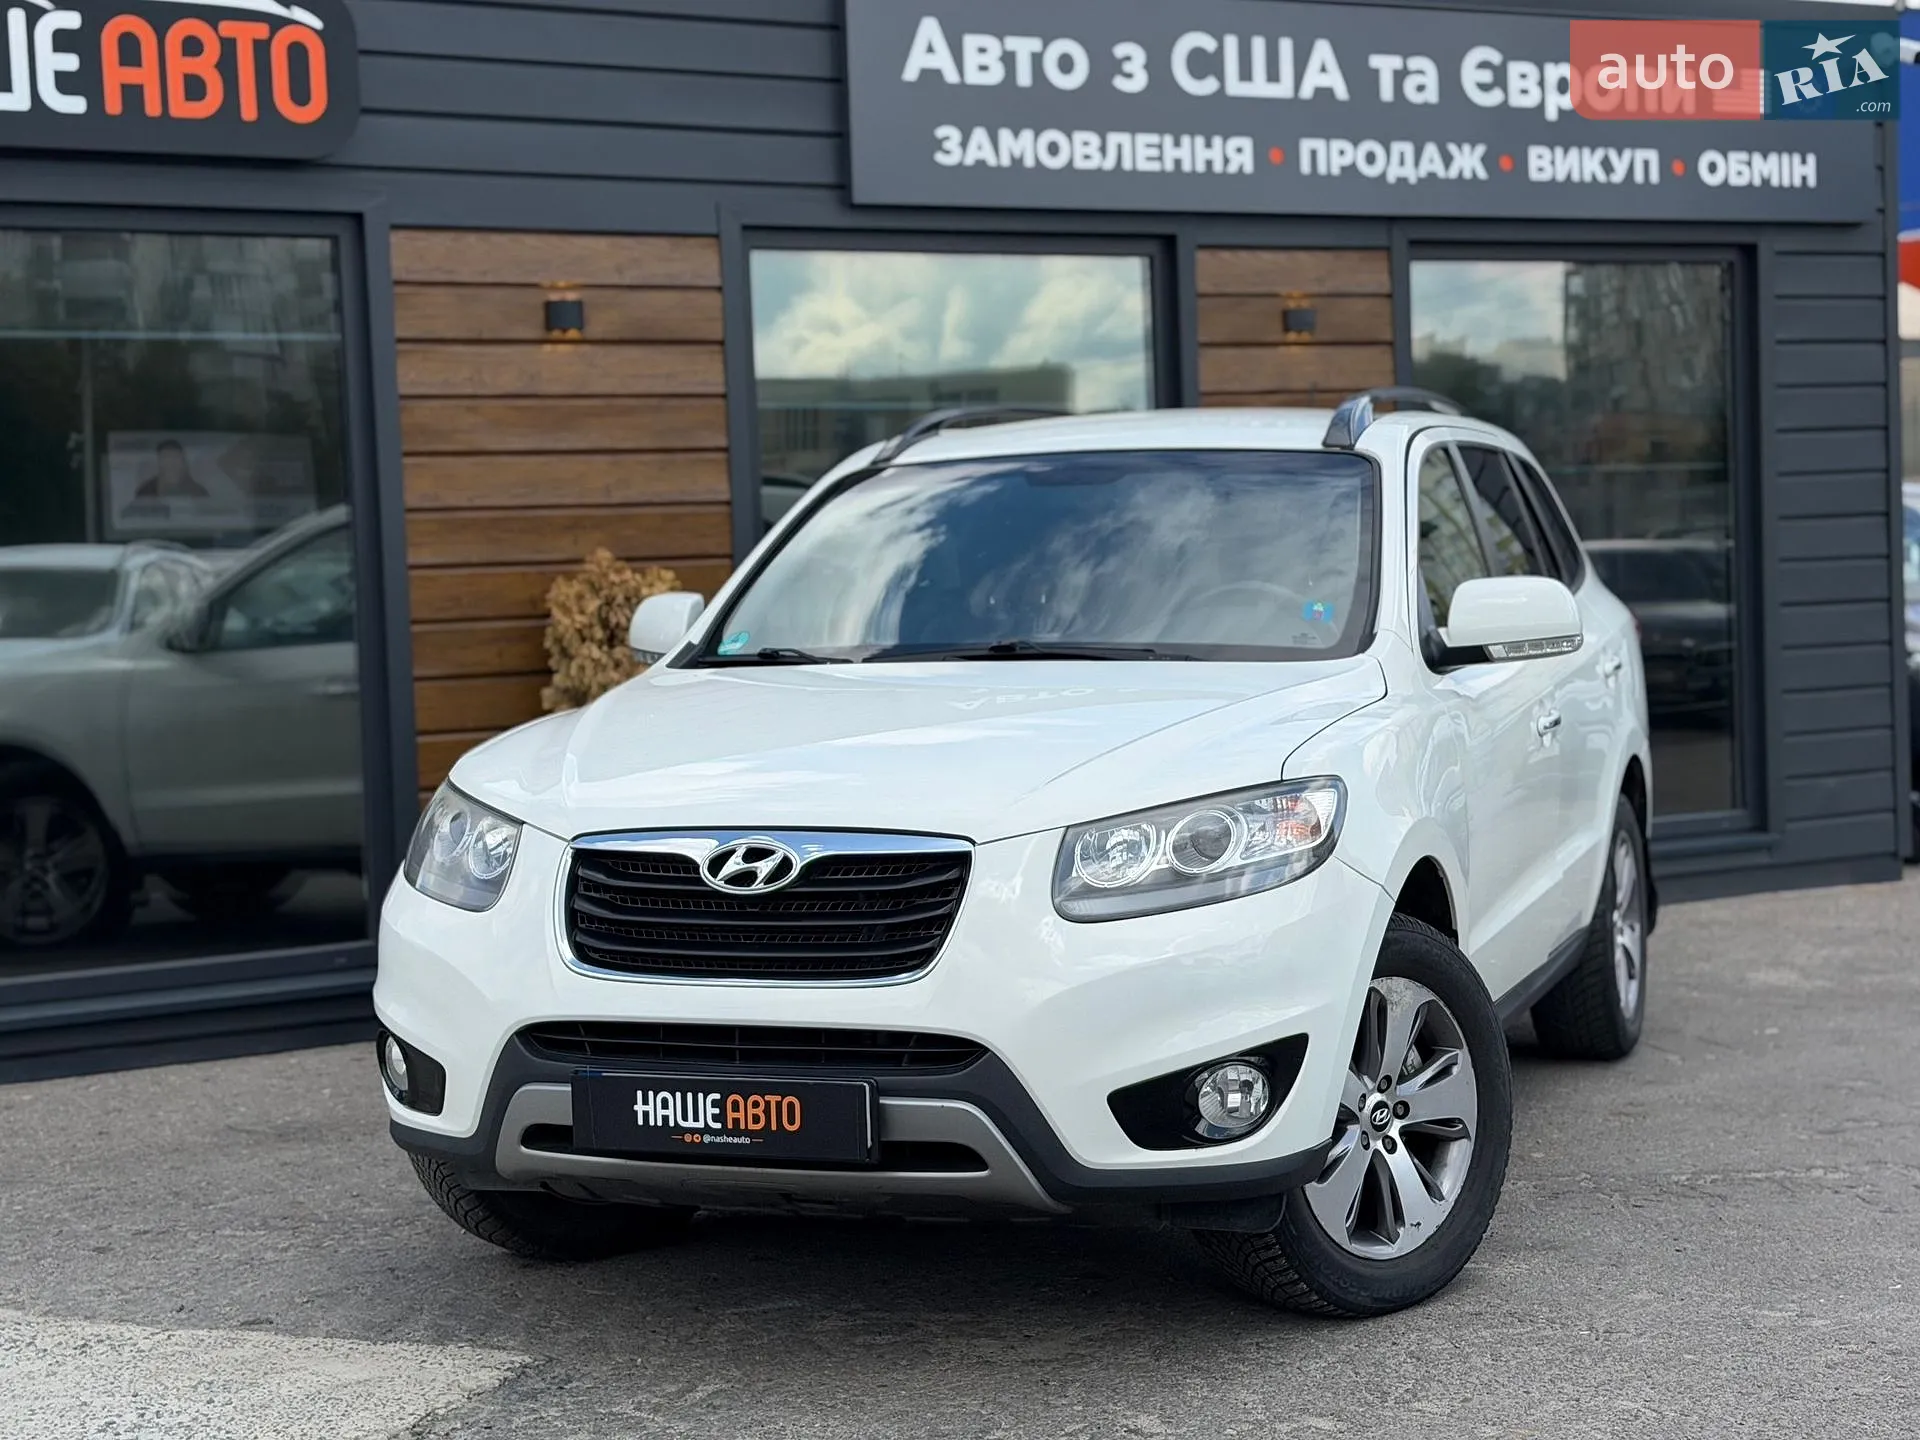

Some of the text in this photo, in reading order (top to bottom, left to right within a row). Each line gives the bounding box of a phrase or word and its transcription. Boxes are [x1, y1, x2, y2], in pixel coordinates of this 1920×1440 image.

[101, 13, 329, 125] АВТО
[1111, 42, 1149, 94] з
[1170, 30, 1350, 102] США
[1367, 53, 1440, 106] та
[932, 124, 1818, 189] ЗАМОВЛЕННЯ ПРОДАЖ ВИКУП ОБМІН
[633, 1090, 801, 1131] НАШЕ АВТО
[702, 1133, 751, 1145] @nasheauto
